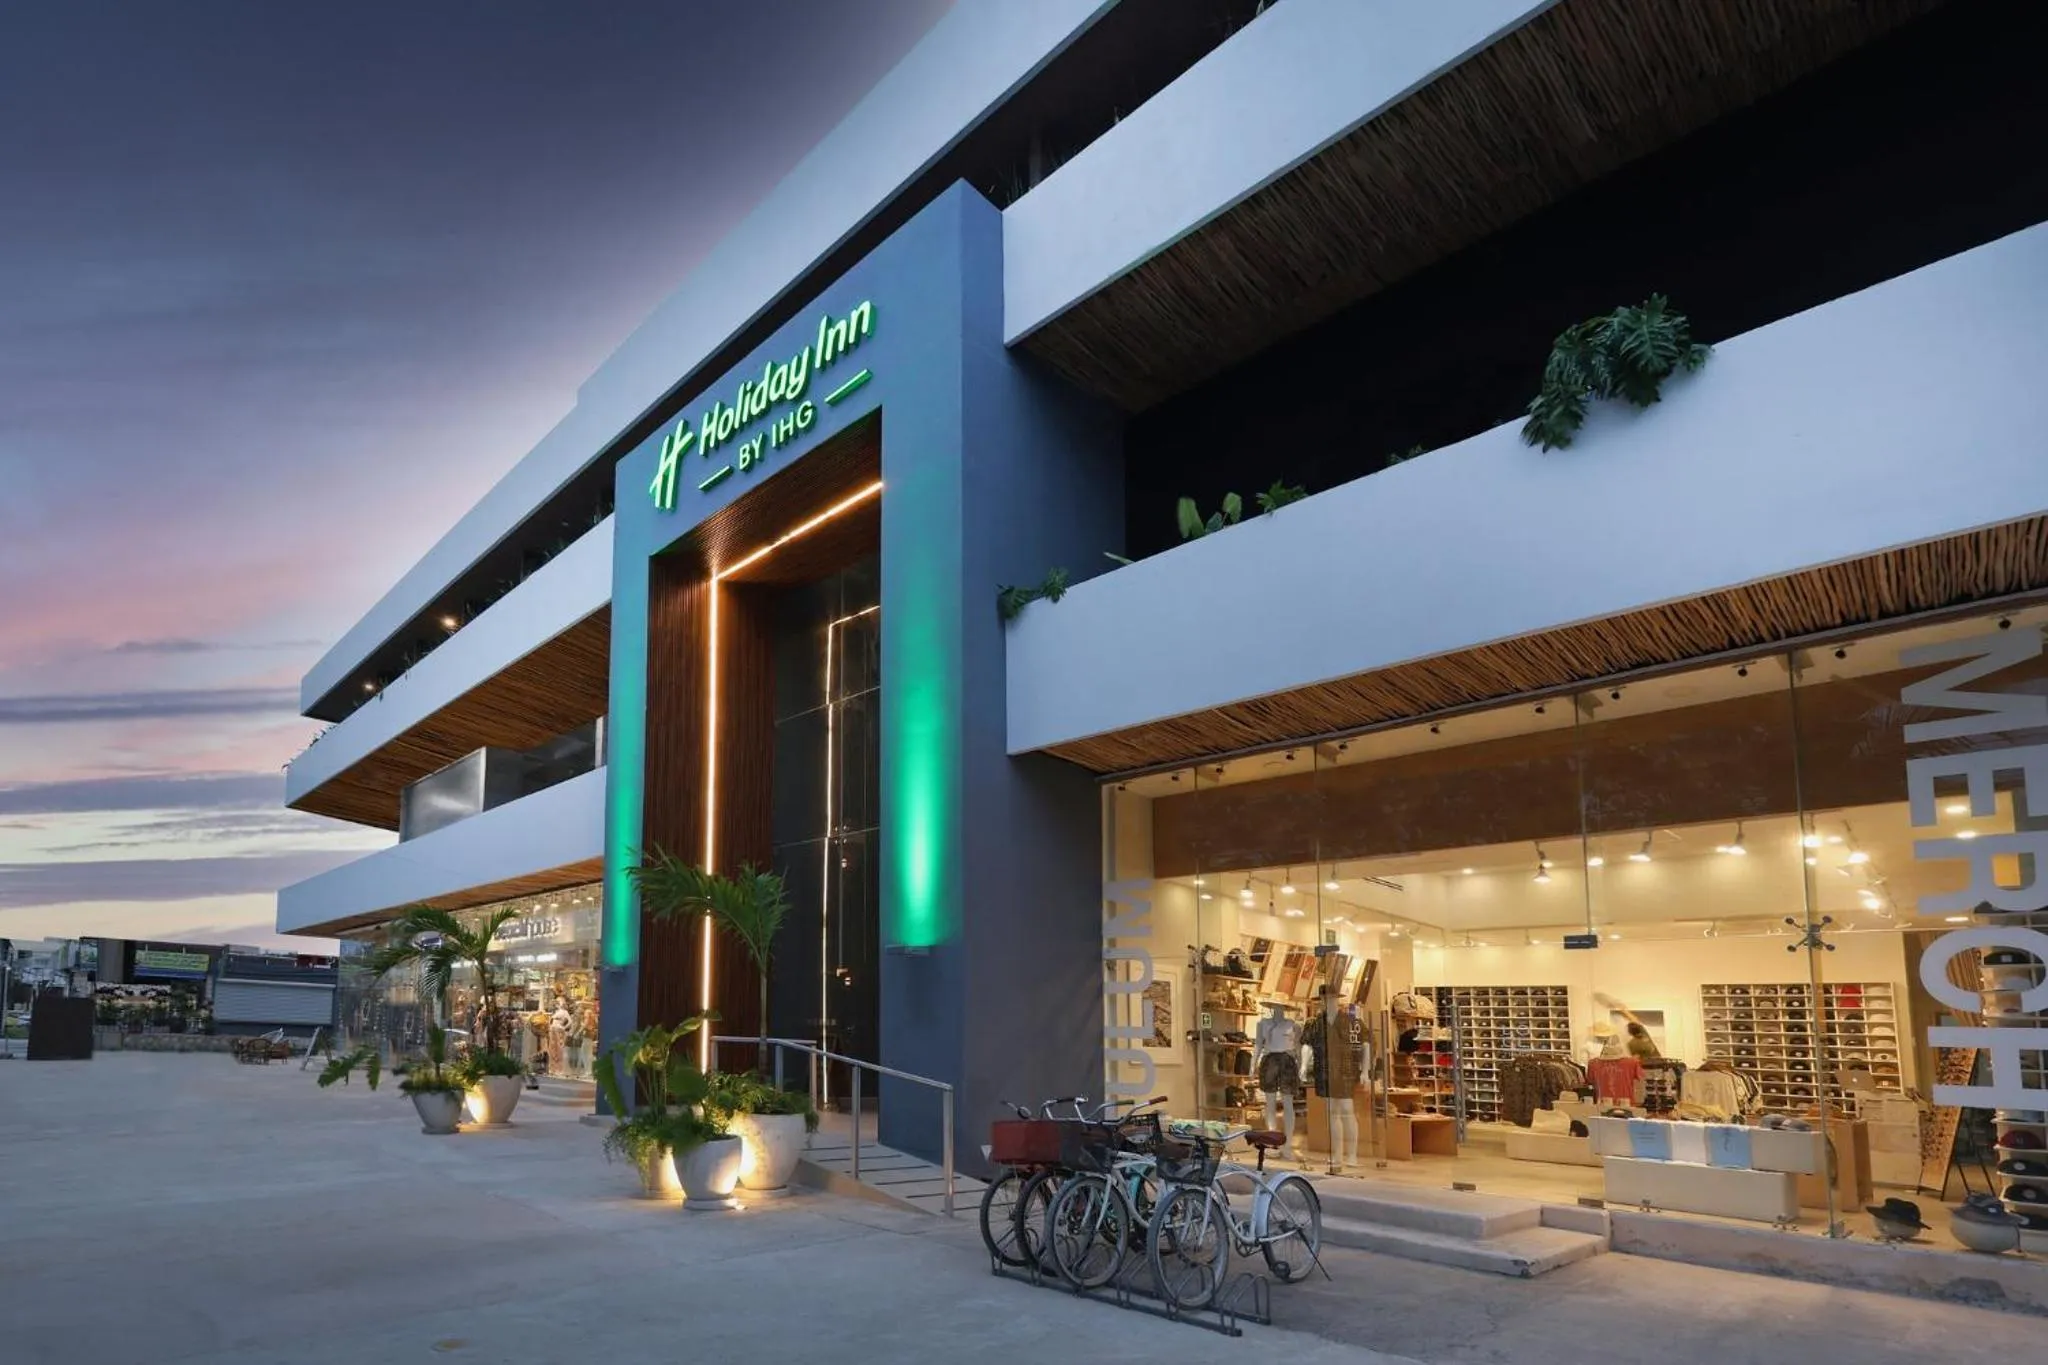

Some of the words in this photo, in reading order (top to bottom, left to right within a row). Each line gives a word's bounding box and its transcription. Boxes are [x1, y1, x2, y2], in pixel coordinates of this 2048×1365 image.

[699, 345, 811, 457] Holiday
[815, 300, 874, 370] Inn
[738, 433, 765, 471] BY
[771, 400, 815, 449] IHG
[1898, 626, 2048, 1112] MERCH
[1103, 877, 1155, 1120] ULUM
